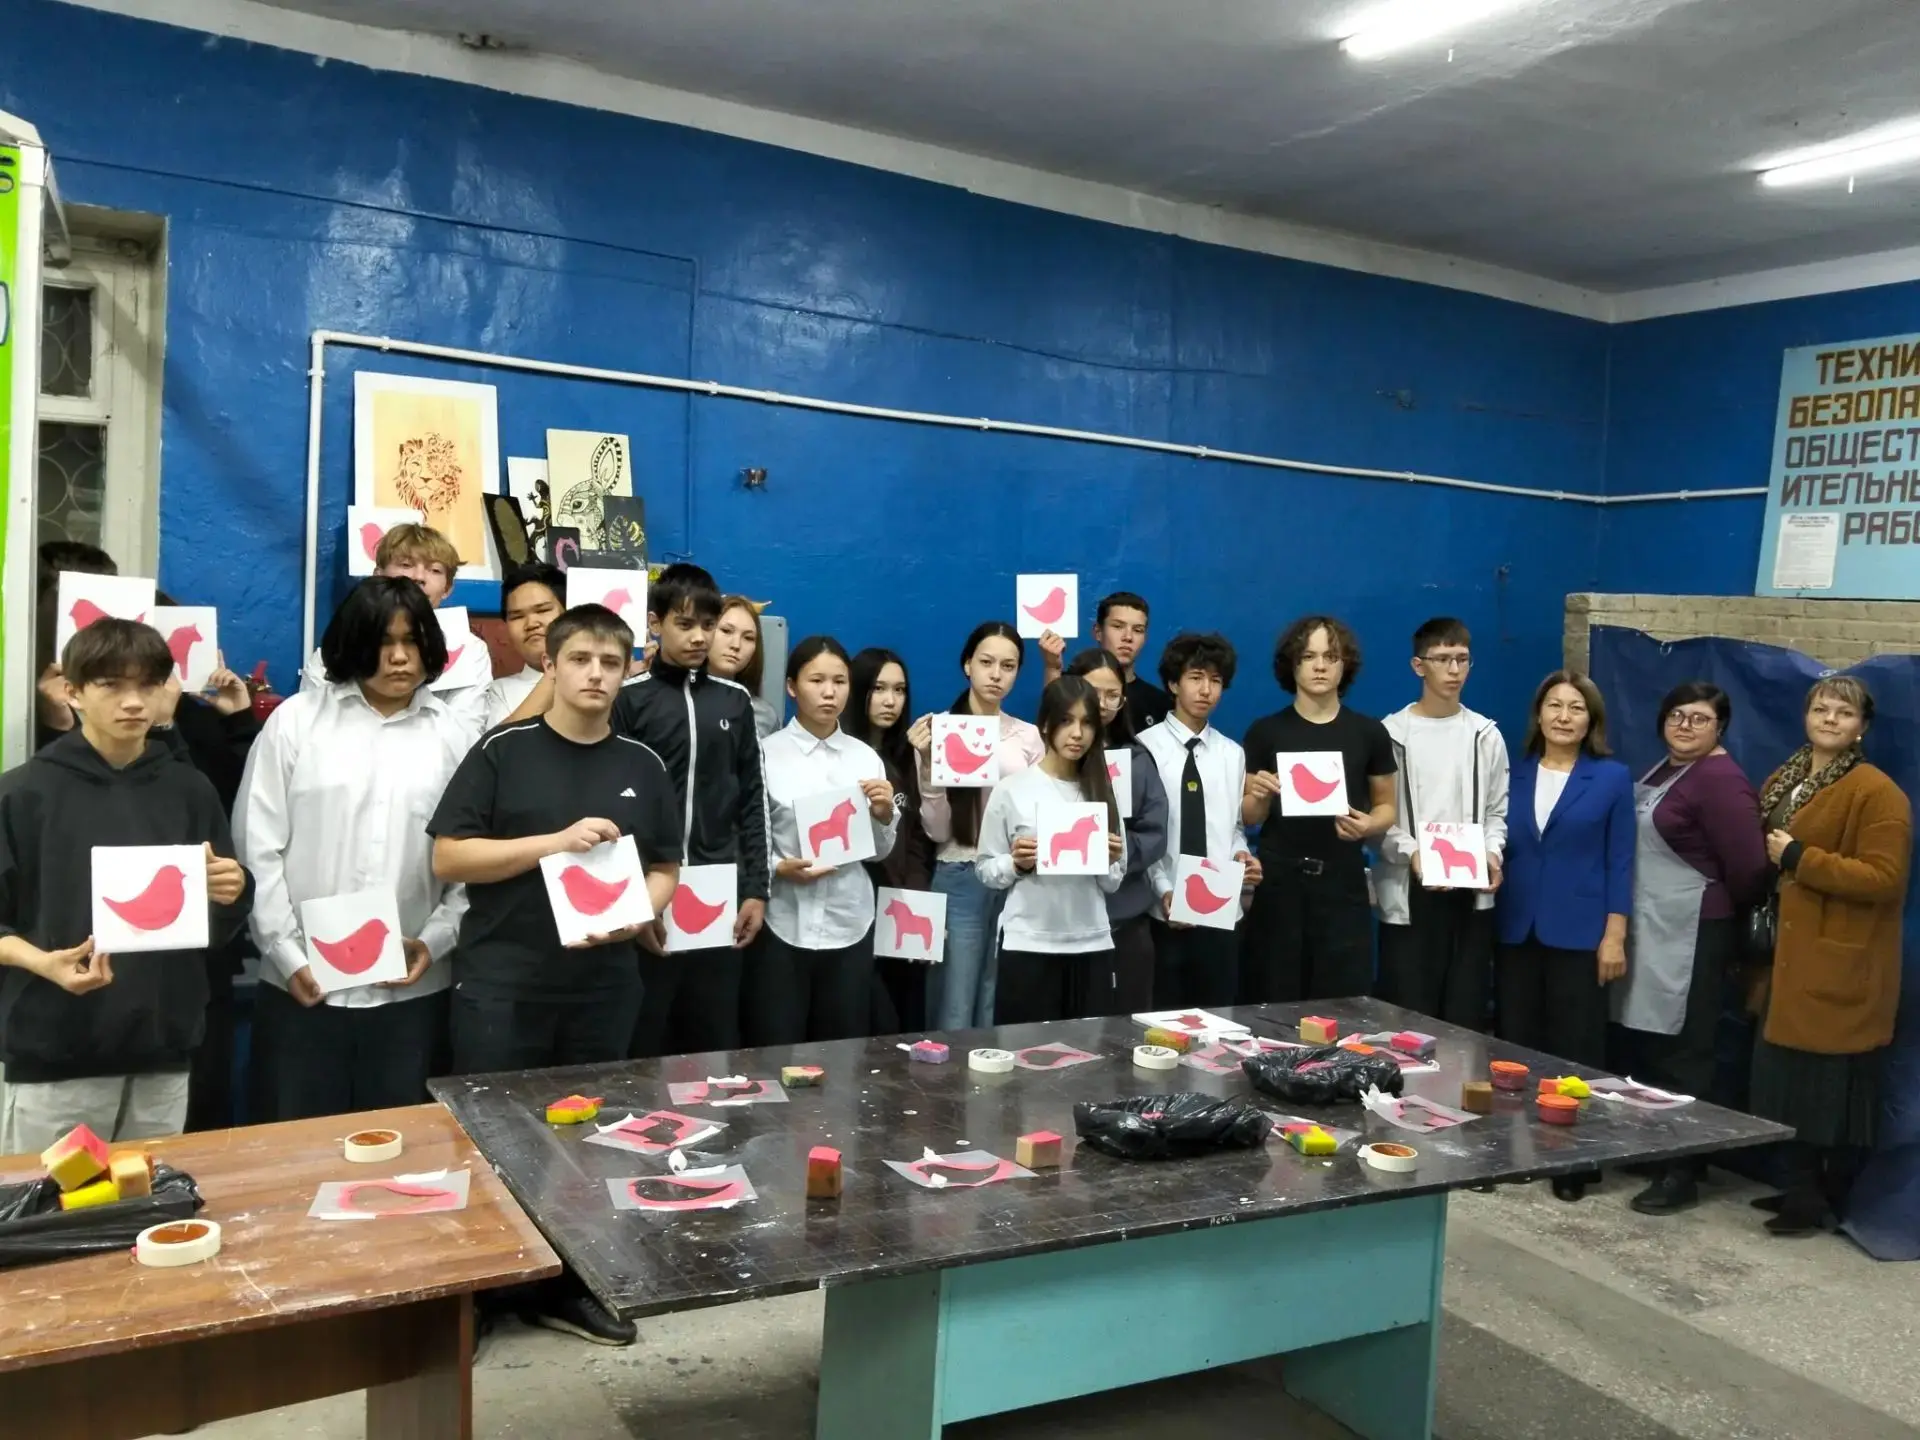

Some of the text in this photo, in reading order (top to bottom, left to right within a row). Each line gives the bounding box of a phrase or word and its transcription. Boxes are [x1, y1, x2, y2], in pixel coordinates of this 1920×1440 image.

[1815, 341, 1920, 386] ТЕХНИ
[1788, 385, 1920, 429] БЕЗОПА
[1785, 428, 1920, 468] ОБЩЕСТ
